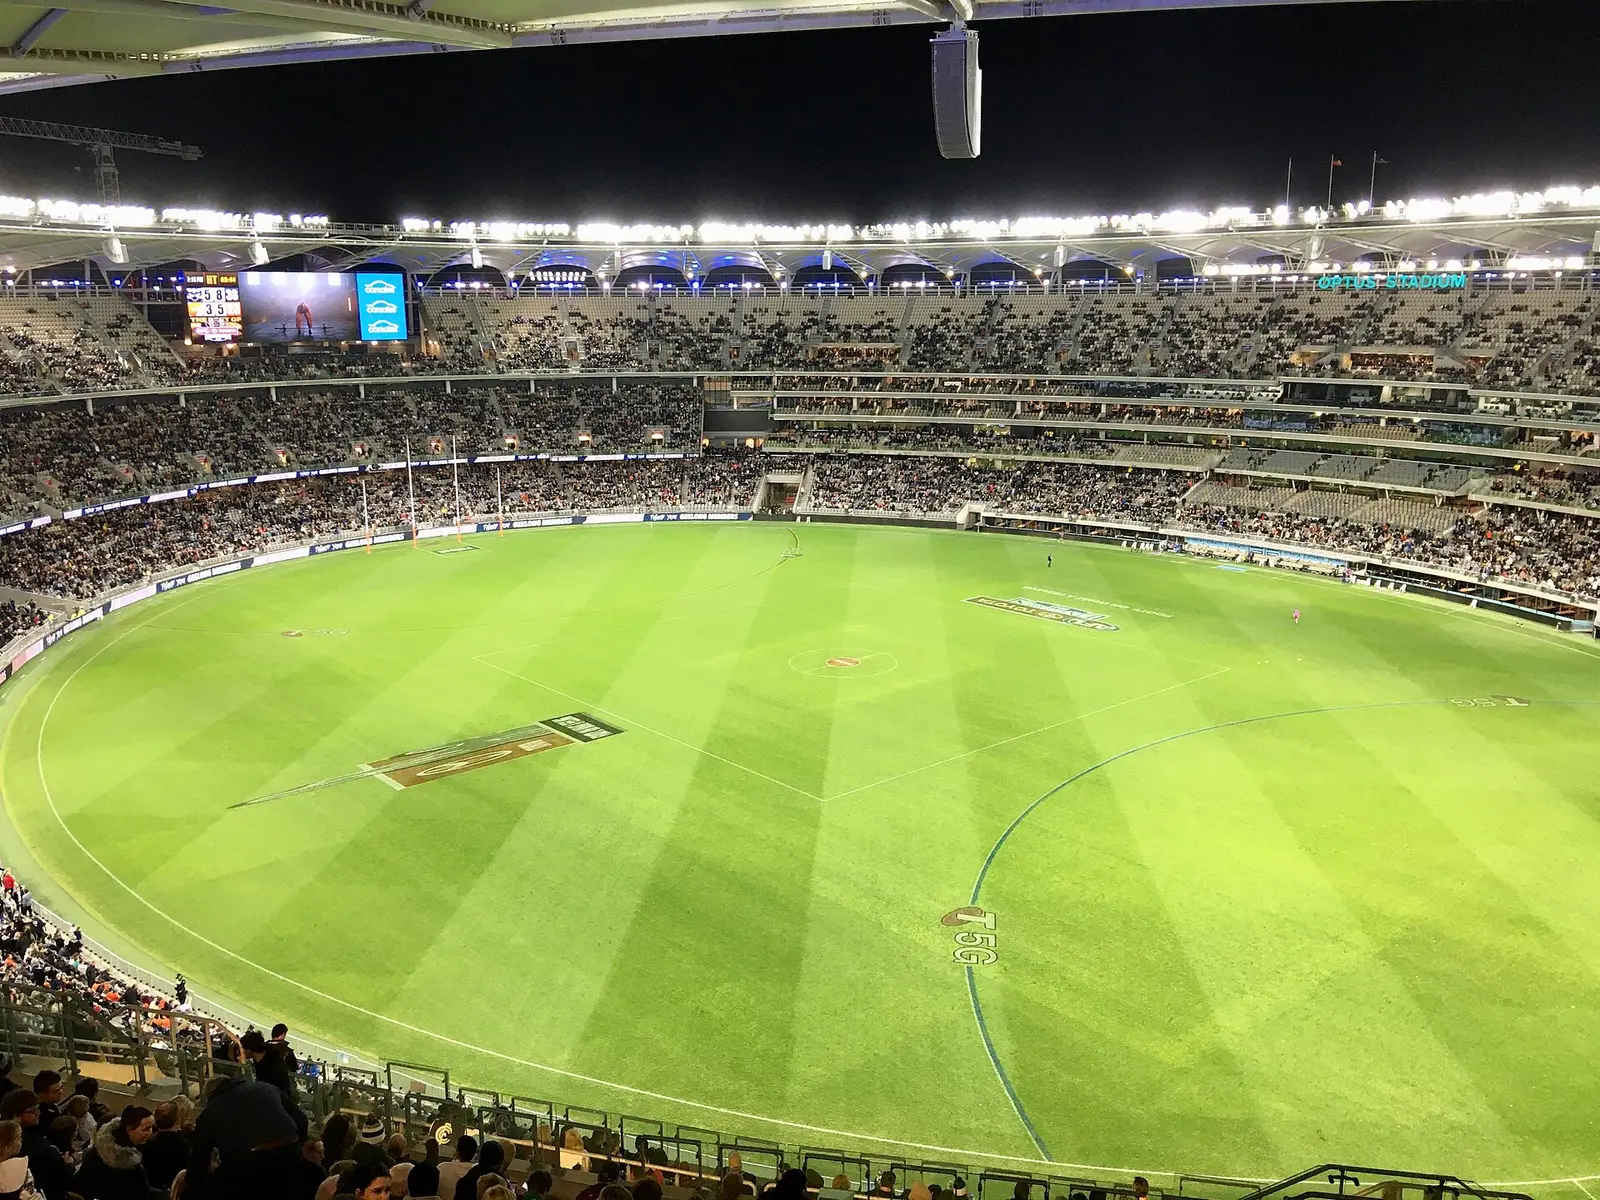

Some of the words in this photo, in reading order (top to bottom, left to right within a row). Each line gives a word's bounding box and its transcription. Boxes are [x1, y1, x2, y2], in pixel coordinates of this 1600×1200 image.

[1317, 275, 1376, 290] OPTUS
[1386, 274, 1467, 289] STADIUM
[204, 289, 211, 301] 5
[216, 289, 223, 301] 8
[206, 303, 212, 315] 3
[217, 303, 224, 315] 5
[977, 597, 1035, 614] TOYOTA
[953, 931, 998, 966] 5G
